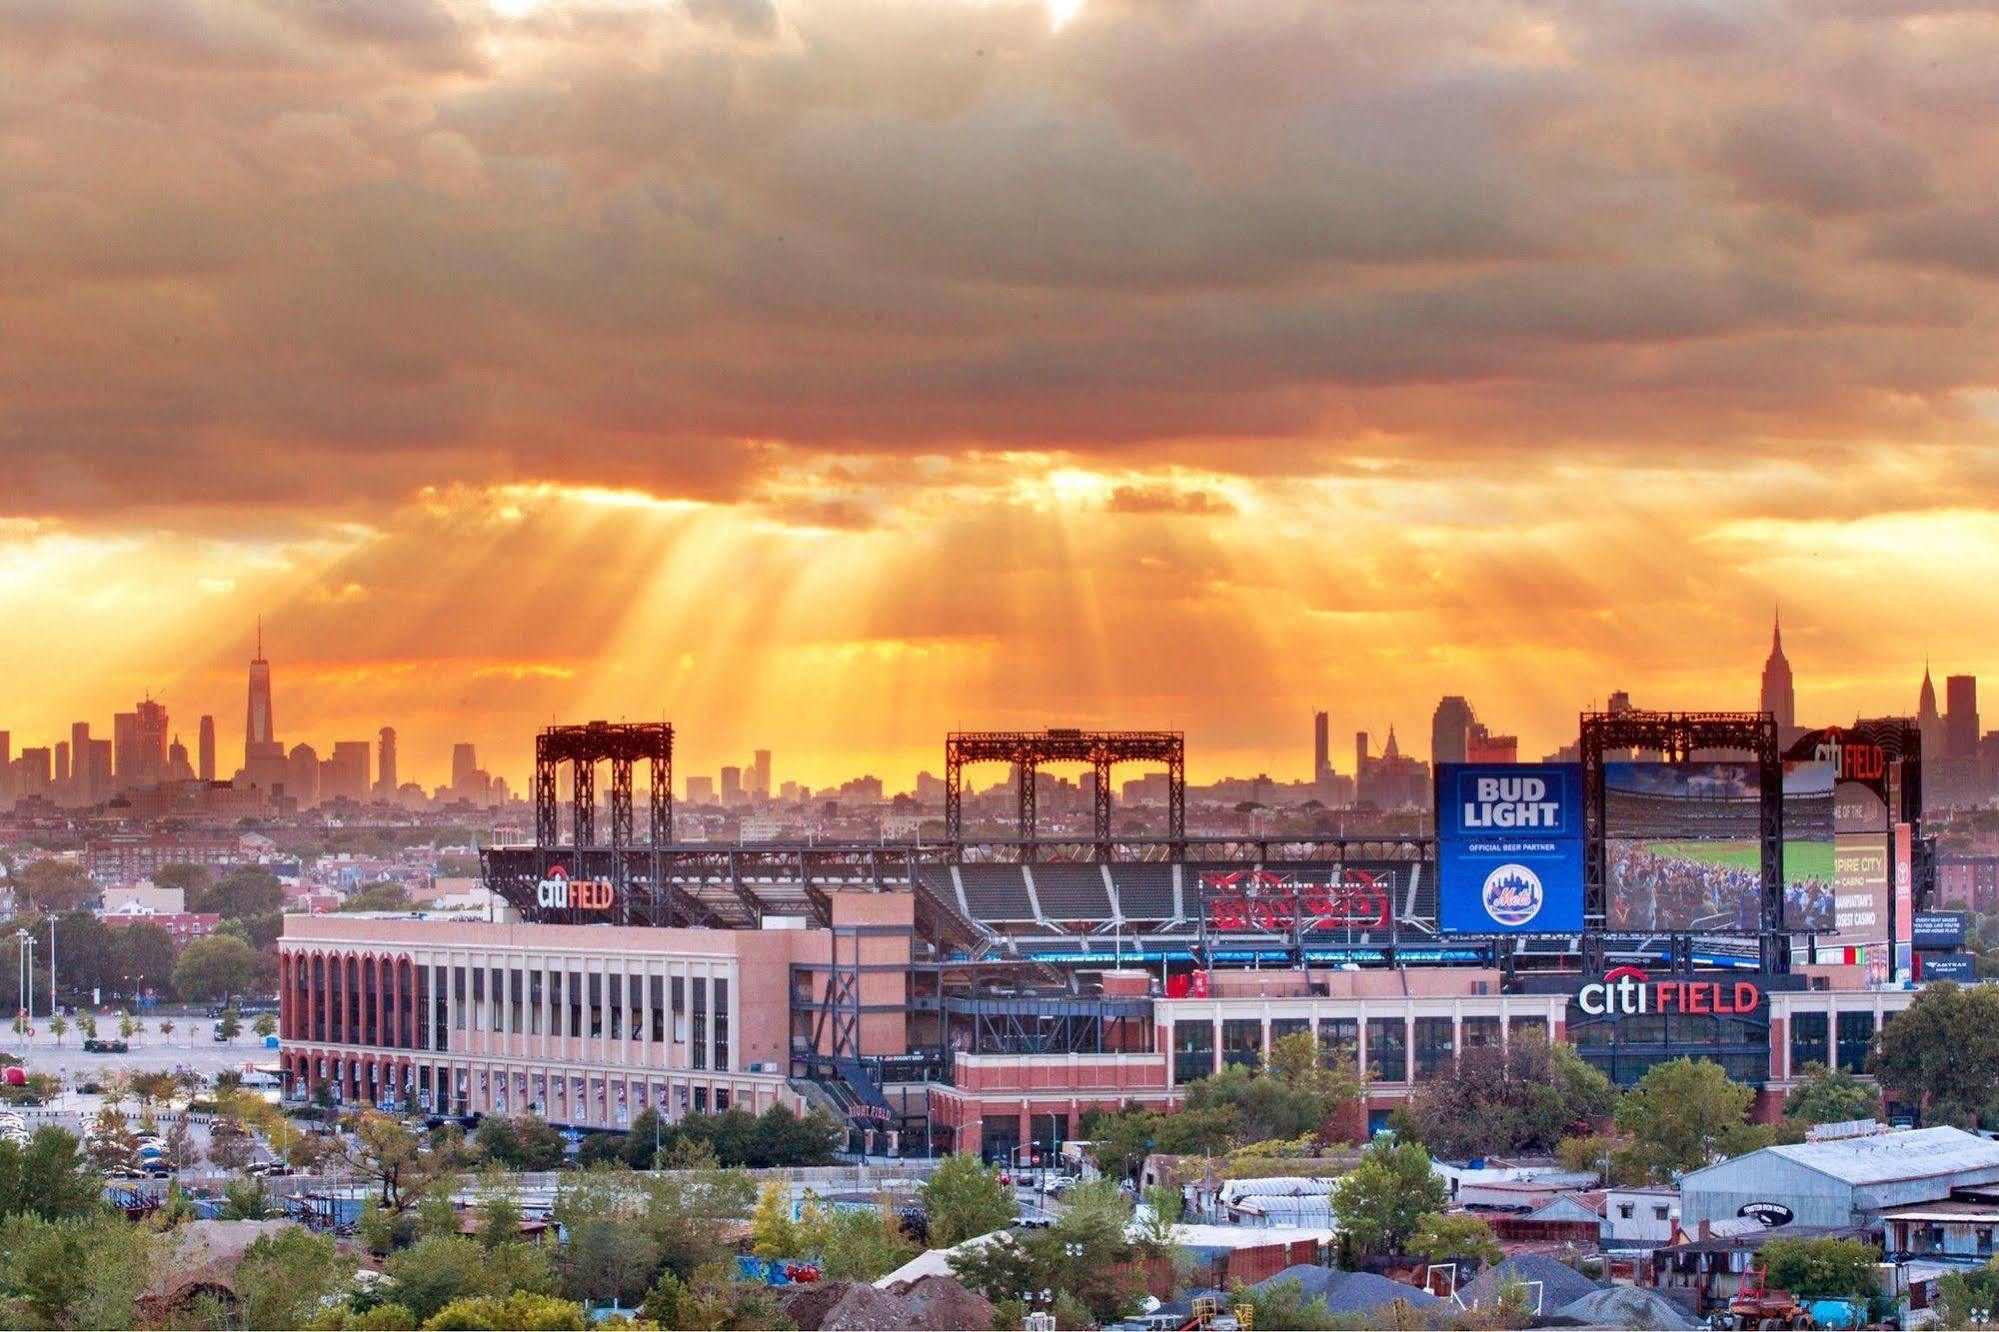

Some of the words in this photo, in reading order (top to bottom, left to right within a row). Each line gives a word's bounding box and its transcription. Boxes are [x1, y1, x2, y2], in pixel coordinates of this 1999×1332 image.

[1843, 745, 1884, 778] FIELD
[1477, 778, 1546, 802] BUD
[1464, 803, 1559, 827] LIGHT
[1843, 805, 1850, 818] OF
[1852, 805, 1862, 818] THE
[1861, 857, 1881, 872] CITY
[1842, 876, 1865, 886] CASINO
[538, 873, 567, 908] citi
[569, 881, 614, 909] FIELD
[1493, 887, 1531, 906] Mets
[1854, 912, 1875, 926] CASINO
[1579, 974, 1647, 1015] citi
[1657, 982, 1758, 1014] FIELD
[849, 1104, 869, 1118] RIGHT
[871, 1106, 891, 1120] FIELD
